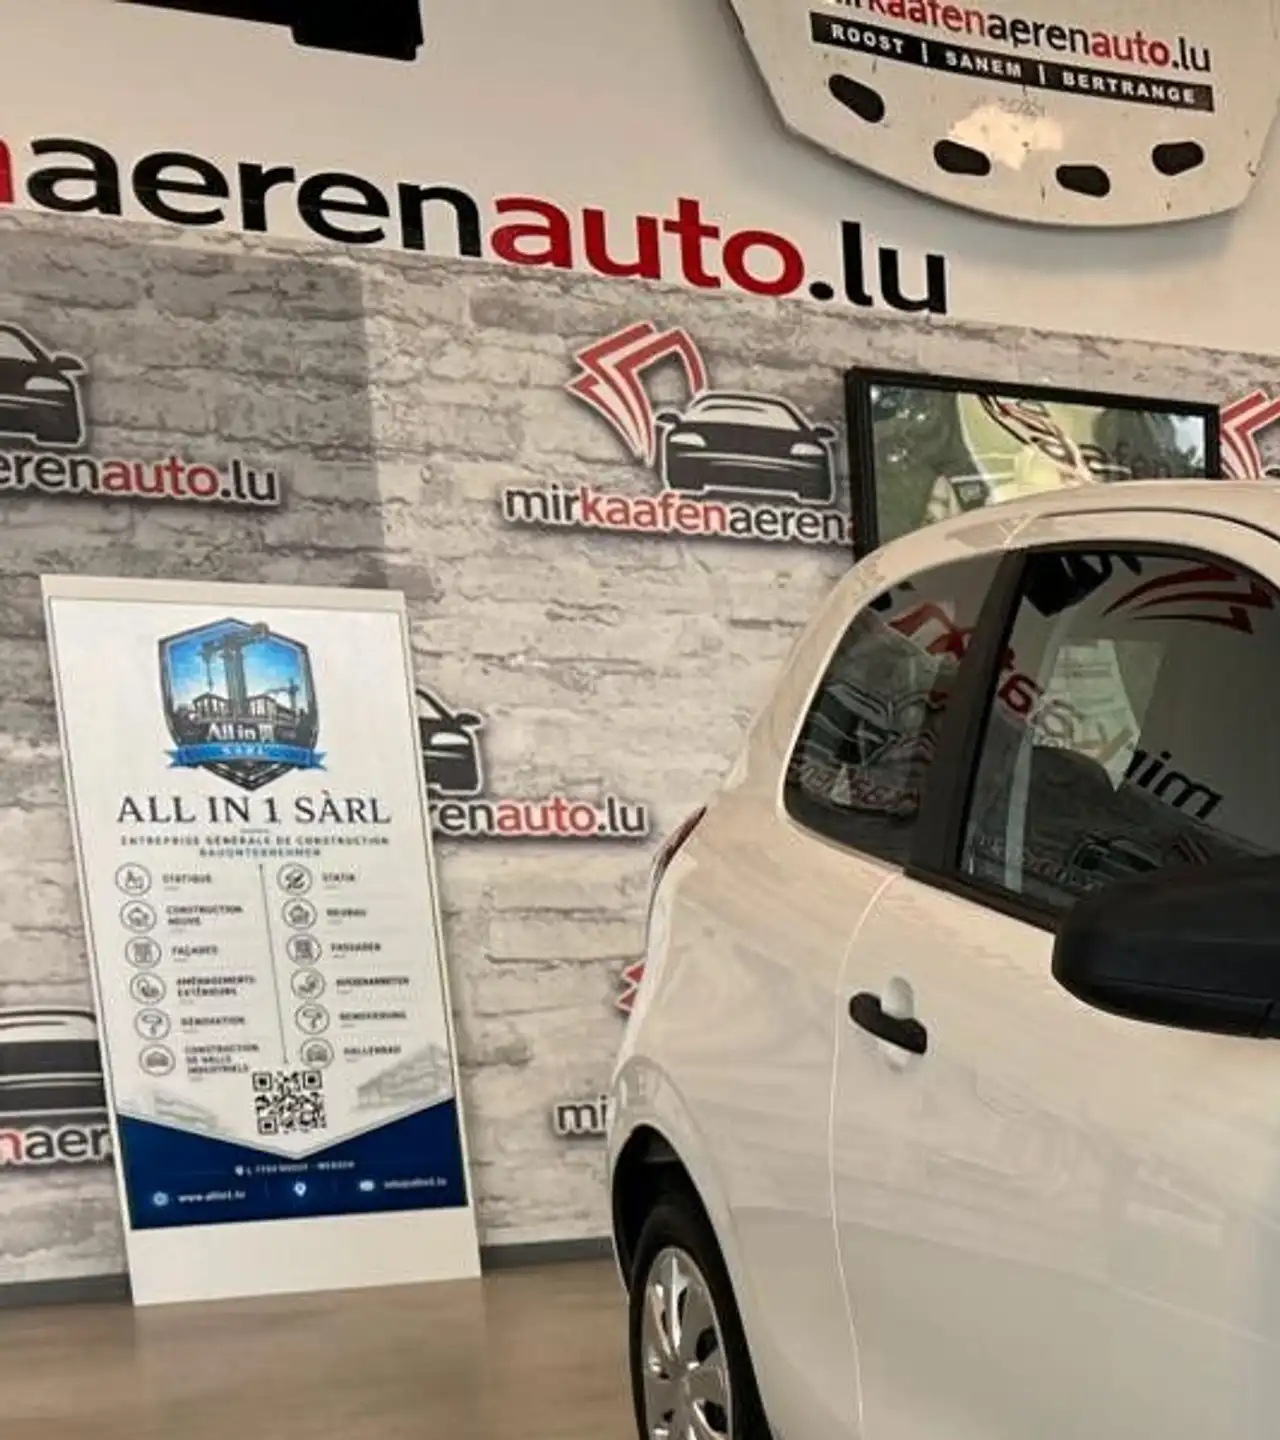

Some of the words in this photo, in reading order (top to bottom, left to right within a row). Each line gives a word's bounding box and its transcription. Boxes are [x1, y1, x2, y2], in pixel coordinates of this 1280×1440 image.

[831, 23, 905, 54] ROOST
[945, 50, 1023, 79] SANEM
[1062, 71, 1197, 104] BERTRANGE
[505, 484, 855, 542] mirkaafenaeren
[117, 795, 196, 824] ALL
[208, 796, 252, 823] IN
[266, 797, 281, 824] 1
